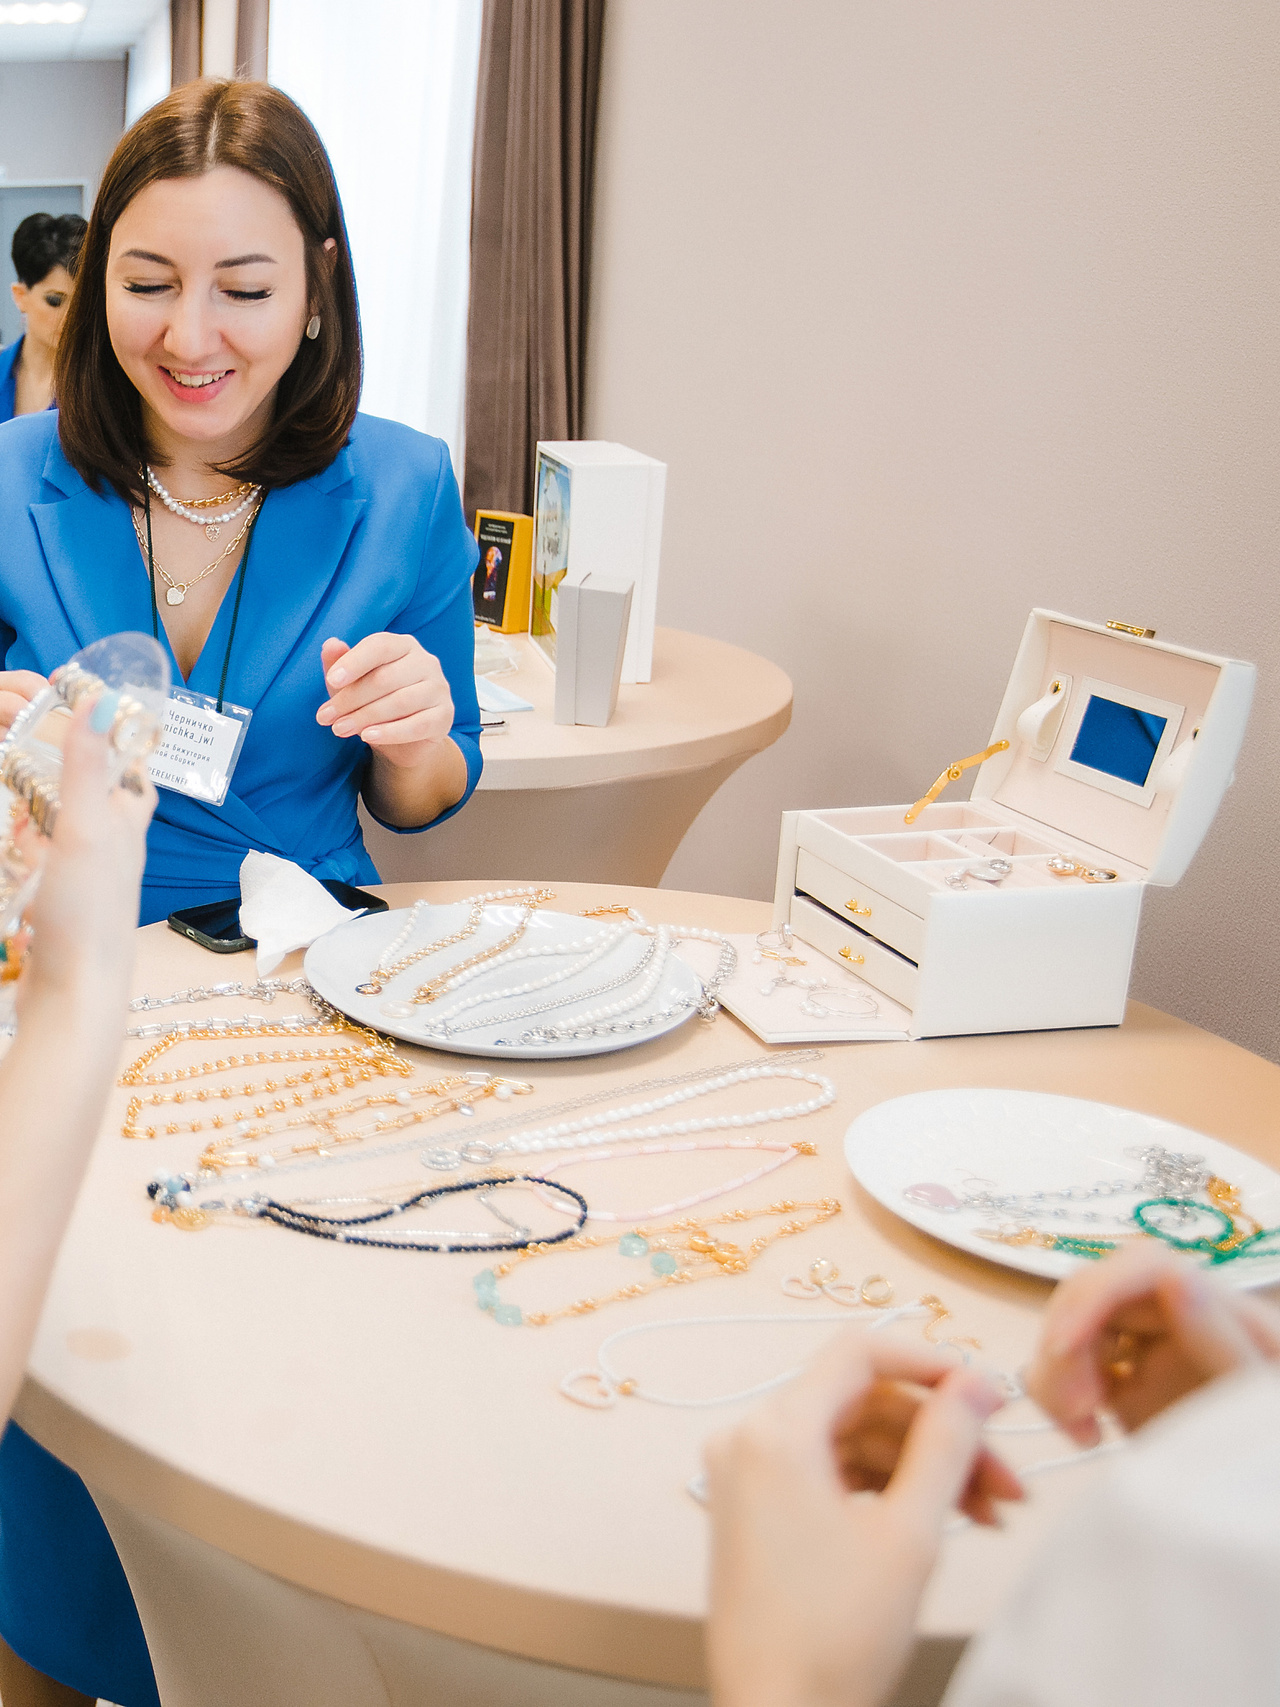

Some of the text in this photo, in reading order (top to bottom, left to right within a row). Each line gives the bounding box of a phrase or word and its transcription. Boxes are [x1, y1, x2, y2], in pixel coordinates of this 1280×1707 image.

[169, 710, 214, 733] Черничко
[163, 723, 214, 746] nichka_jwl
[173, 744, 211, 762] бижутерия
